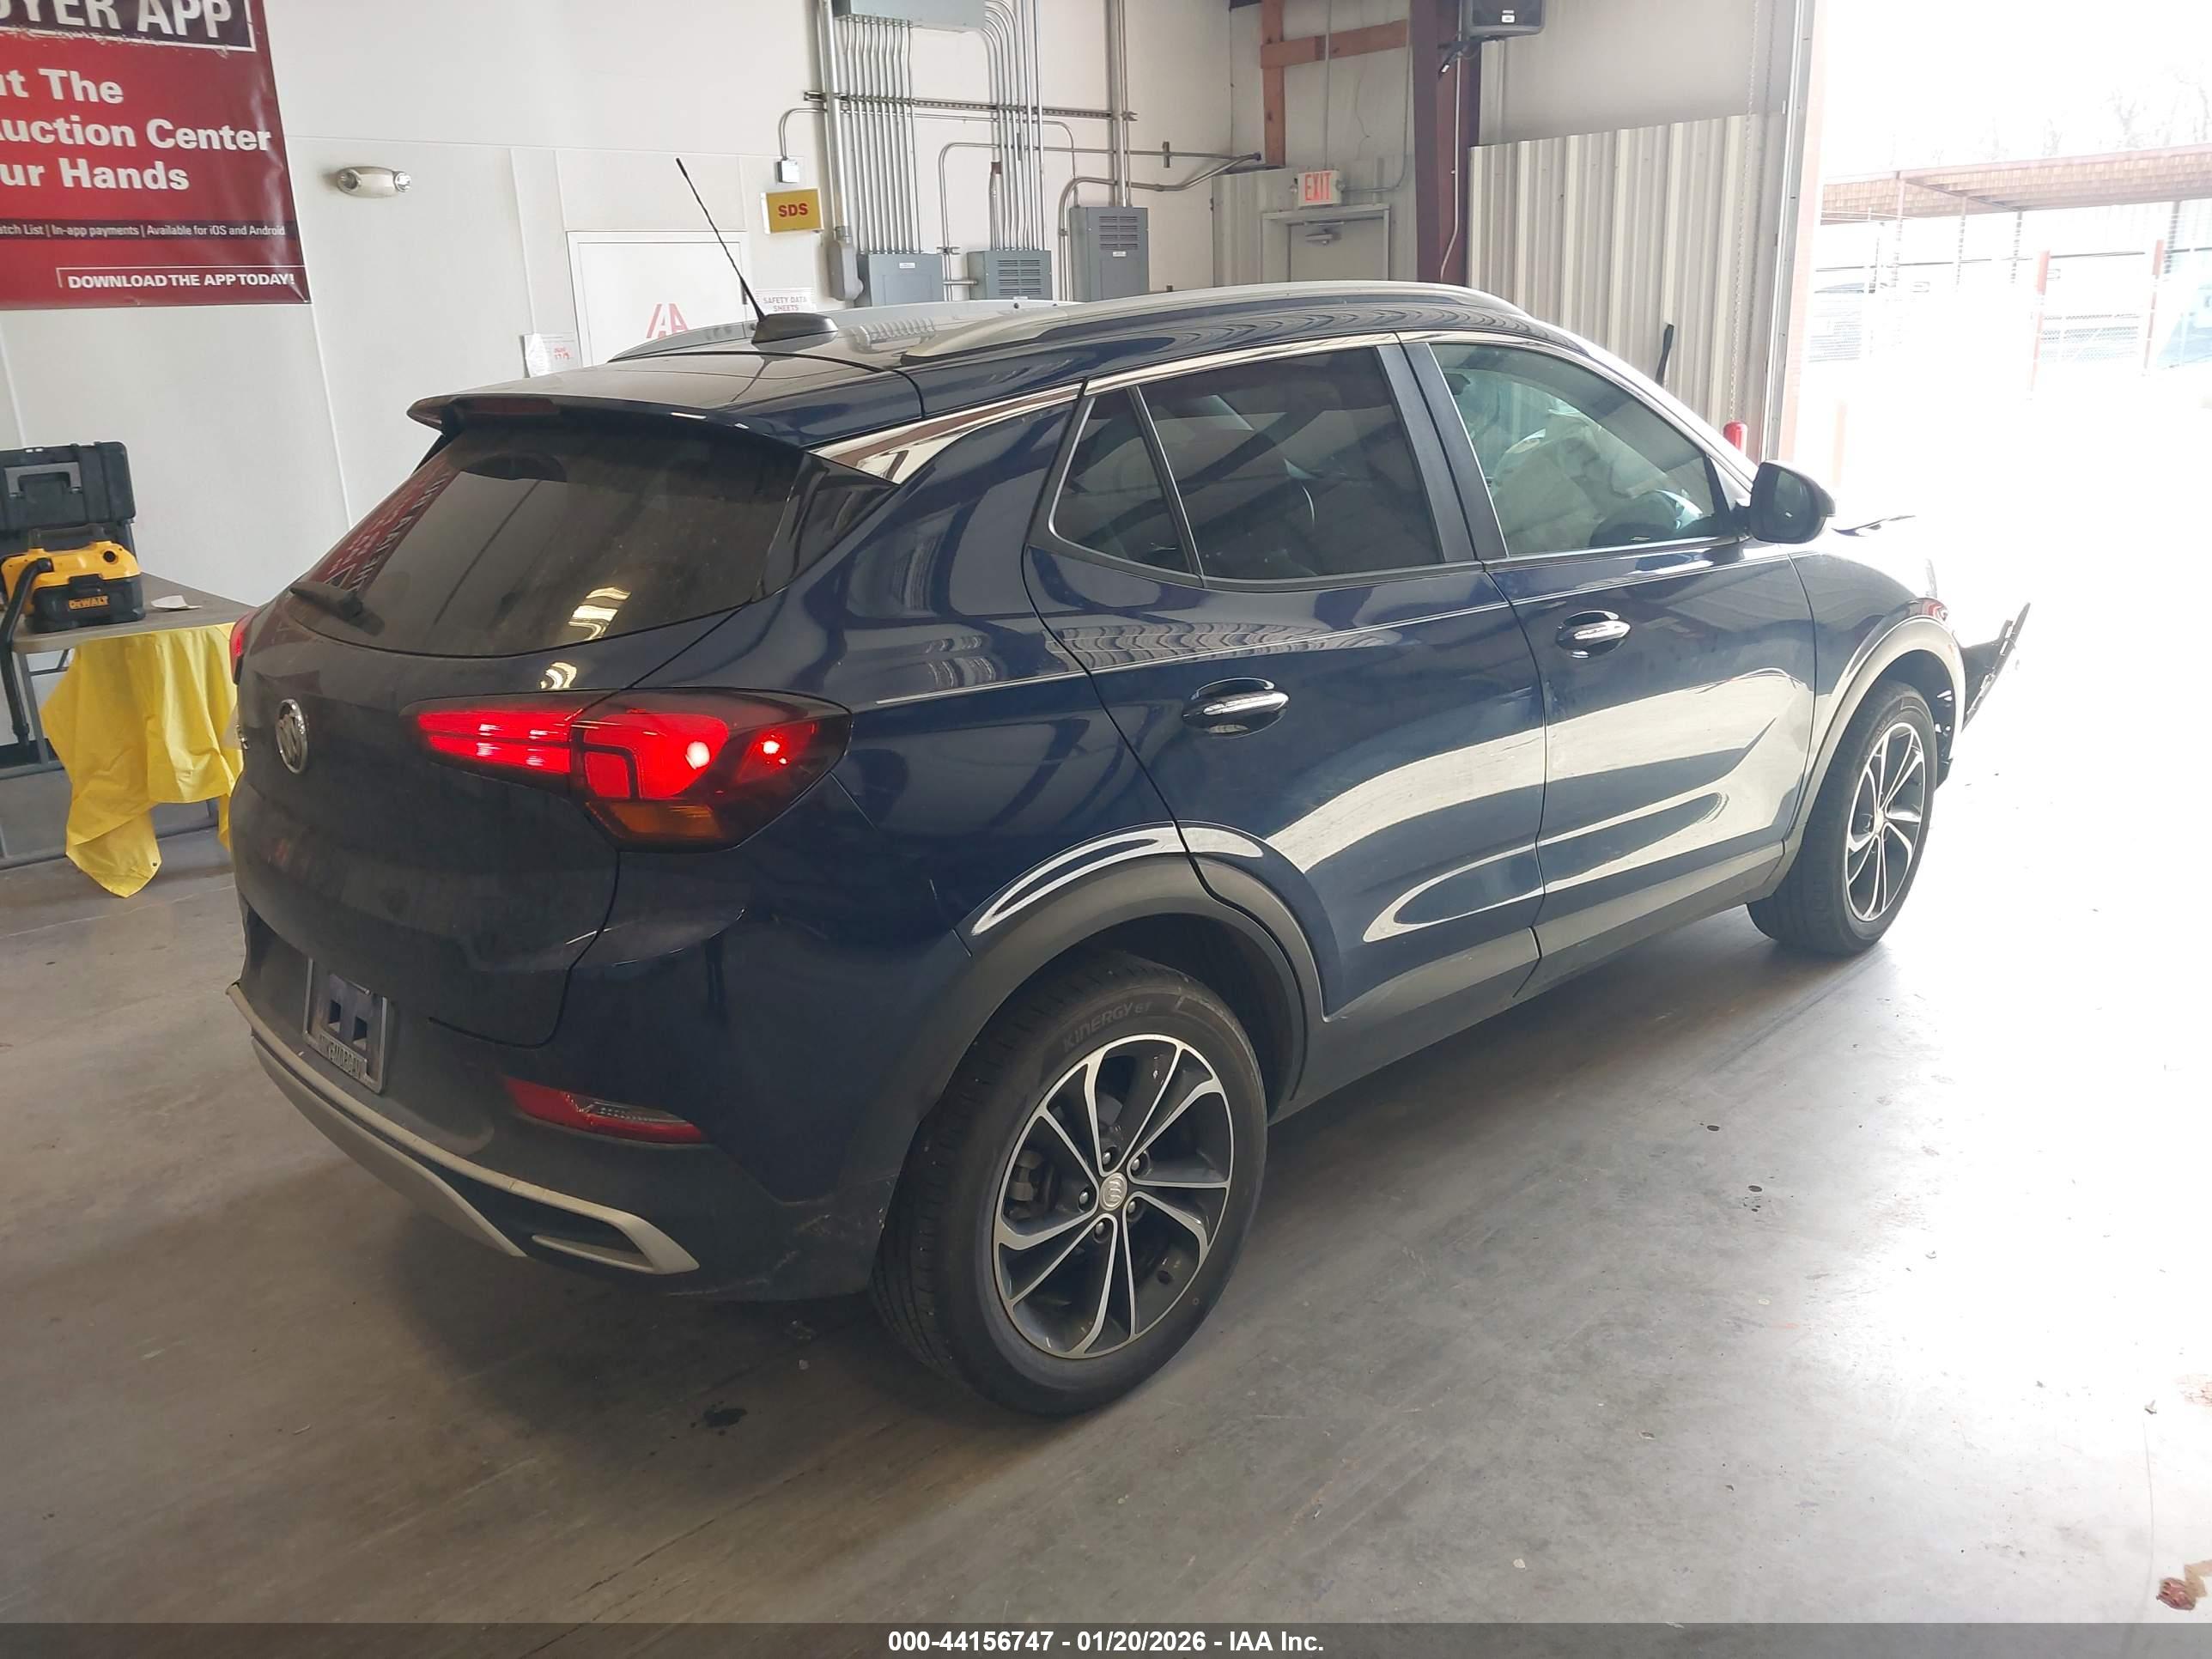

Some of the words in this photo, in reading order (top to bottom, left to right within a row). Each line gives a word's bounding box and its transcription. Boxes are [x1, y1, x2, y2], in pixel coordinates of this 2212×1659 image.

[137, 0, 232, 38] APP
[38, 68, 125, 104] The
[0, 114, 137, 148] uction
[146, 118, 271, 151] Center
[58, 157, 190, 191] Hands
[1304, 172, 1332, 201] EXIT
[778, 203, 809, 217] SDS
[89, 226, 139, 238] payments
[147, 225, 192, 235] Available
[193, 225, 208, 235] for
[228, 225, 248, 235] and
[68, 275, 167, 289] DOWNLOAD
[168, 274, 201, 288] THE
[204, 274, 236, 287] APP
[236, 273, 295, 286] TODAY!
